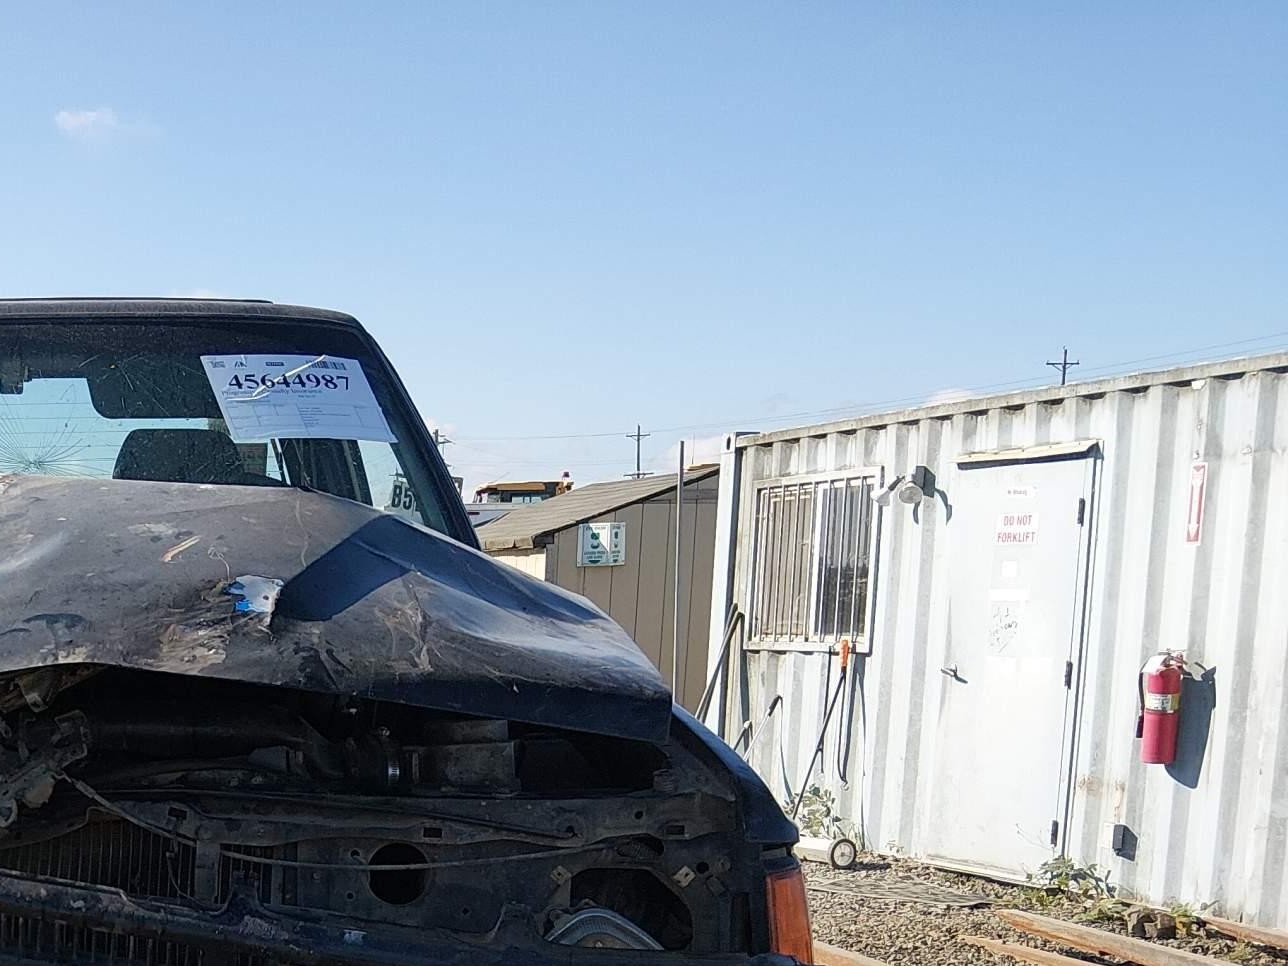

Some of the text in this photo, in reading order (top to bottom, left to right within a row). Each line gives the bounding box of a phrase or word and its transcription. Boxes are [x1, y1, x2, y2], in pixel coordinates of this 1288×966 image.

[228, 373, 349, 391] 45644987
[1003, 514, 1033, 526] DO NOT
[997, 531, 1036, 543] FORKLIFT
